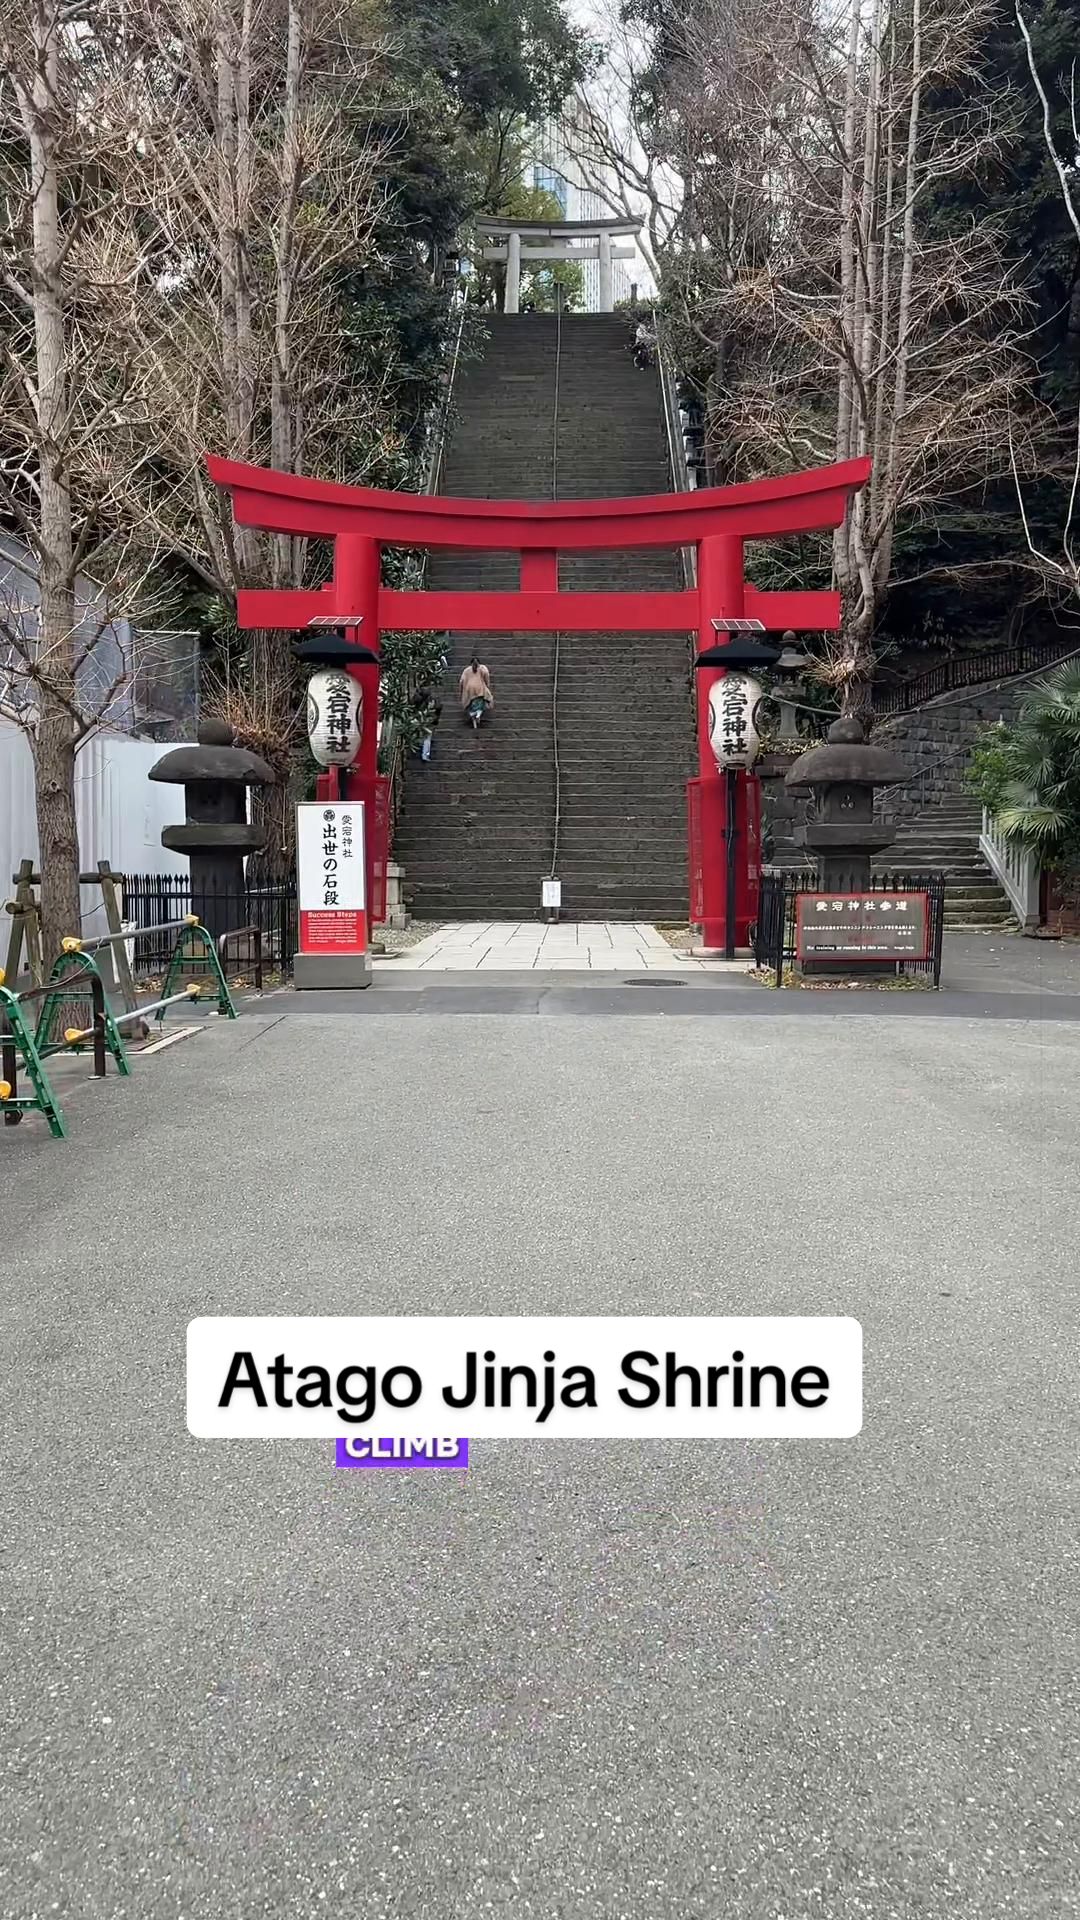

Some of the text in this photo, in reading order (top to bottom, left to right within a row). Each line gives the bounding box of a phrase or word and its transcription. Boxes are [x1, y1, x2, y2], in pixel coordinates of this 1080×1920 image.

[326, 674, 351, 753] 愛宕神社
[722, 678, 749, 756] 愛宕神社
[322, 824, 340, 906] 出世の石段
